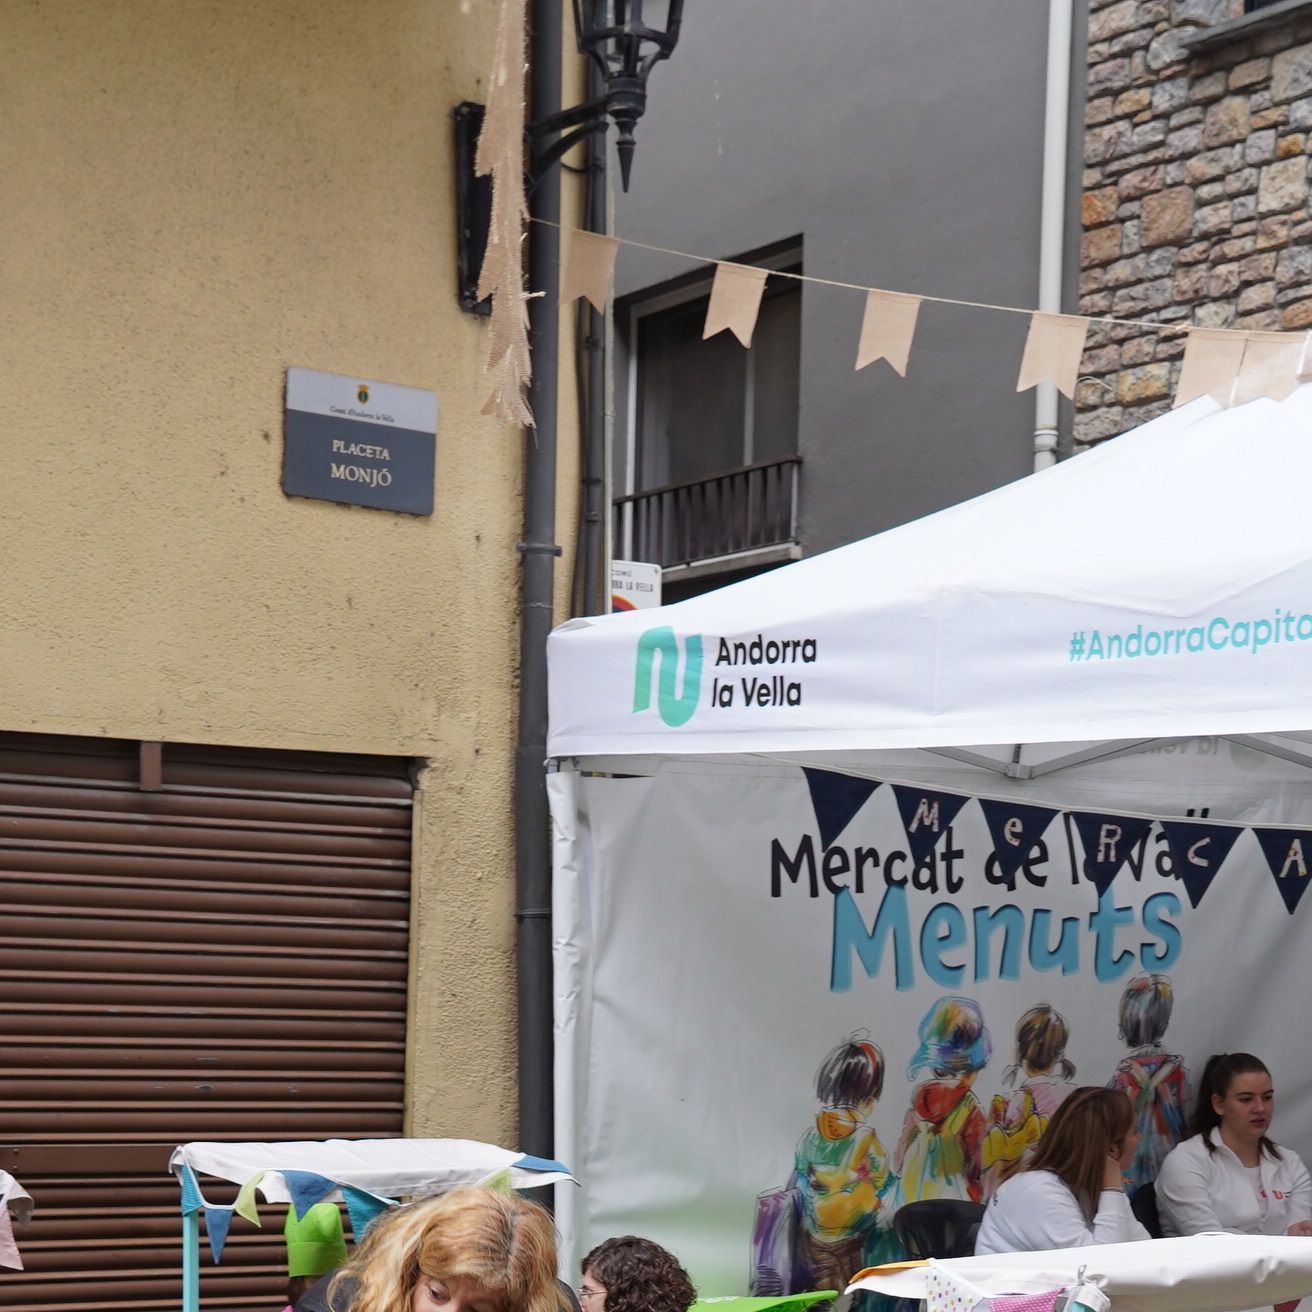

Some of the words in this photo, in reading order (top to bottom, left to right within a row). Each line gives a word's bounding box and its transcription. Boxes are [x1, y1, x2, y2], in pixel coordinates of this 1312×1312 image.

[332, 439, 391, 461] PLACETA
[330, 463, 392, 488] MONJÓ
[715, 634, 817, 667] Andorra
[711, 677, 734, 708] la
[741, 675, 802, 707] Vella
[830, 884, 1184, 992] Menuts
